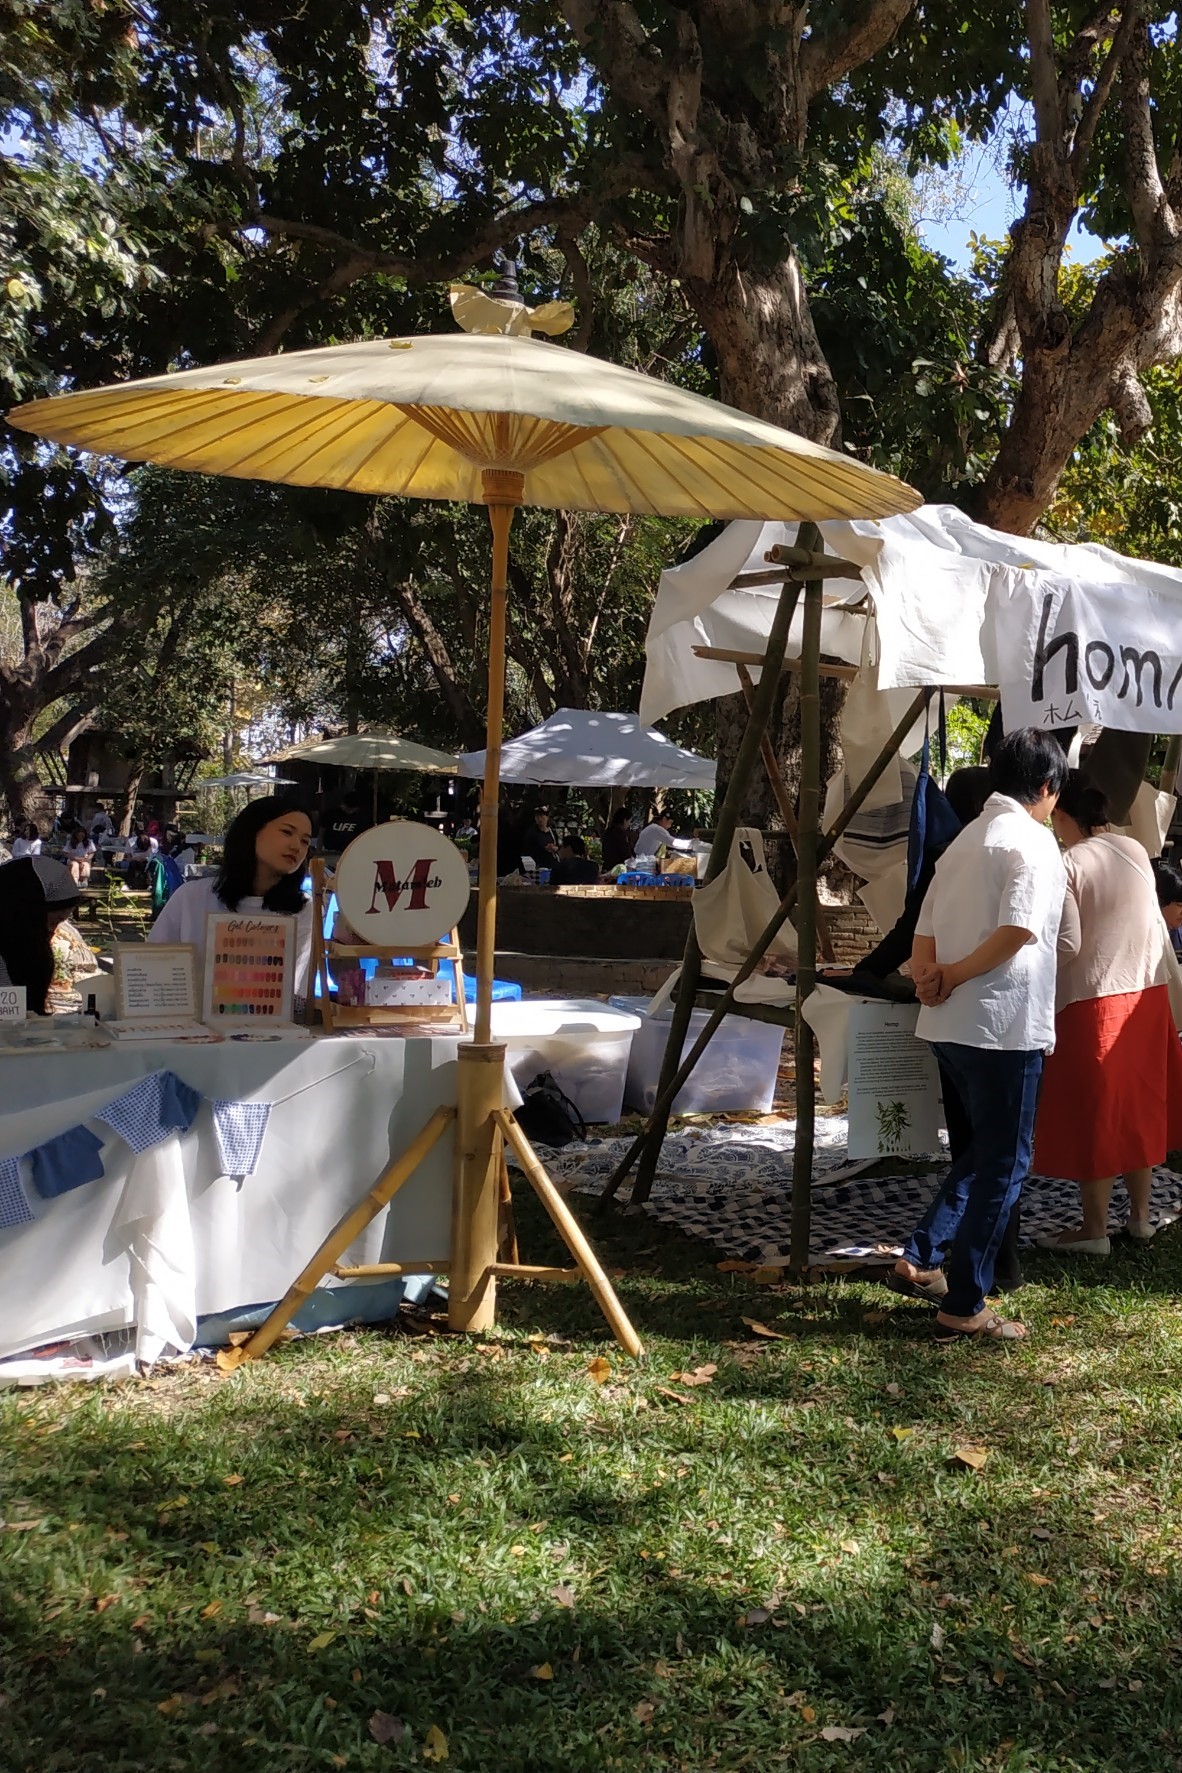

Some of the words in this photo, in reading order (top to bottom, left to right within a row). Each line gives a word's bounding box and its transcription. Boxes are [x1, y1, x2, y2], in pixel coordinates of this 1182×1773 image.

[333, 822, 357, 832] LIFE
[365, 858, 438, 914] M
[1, 991, 18, 1005] 20
